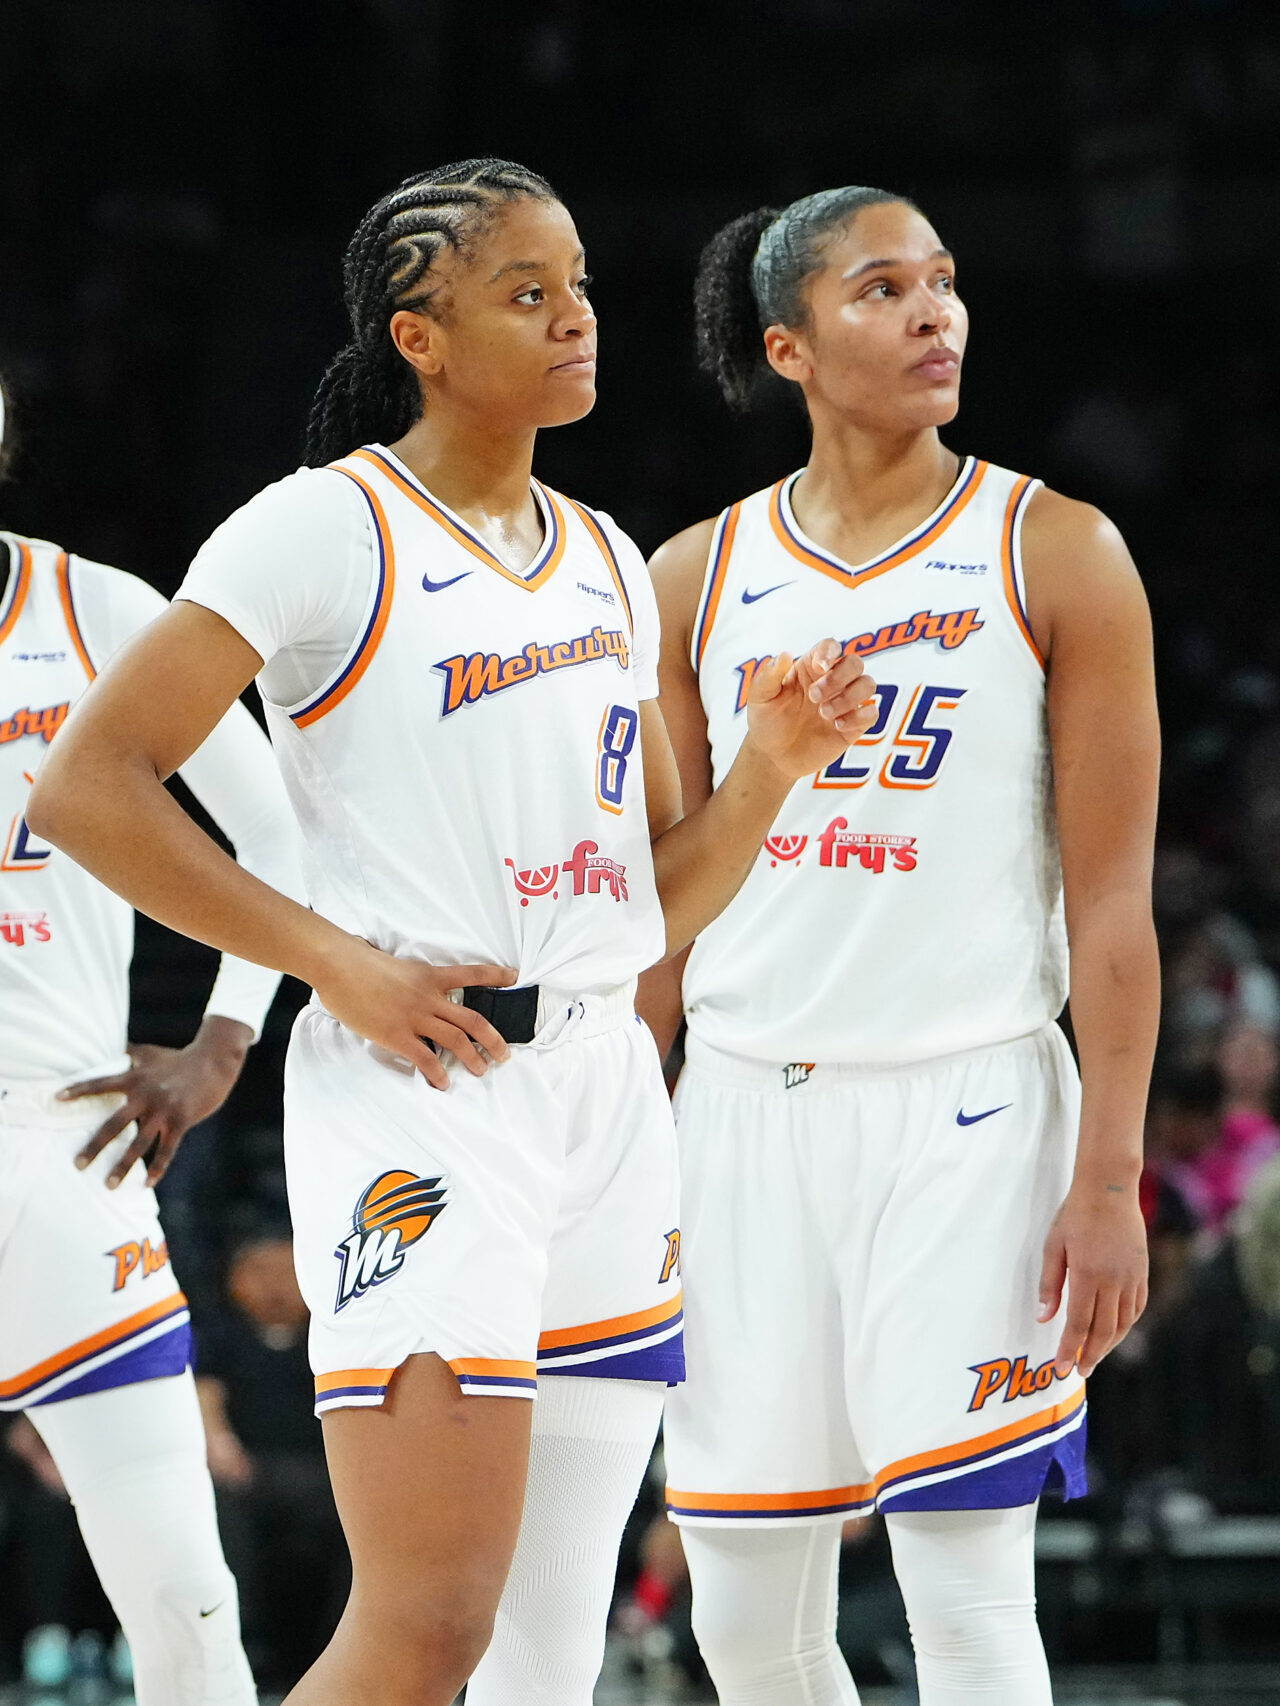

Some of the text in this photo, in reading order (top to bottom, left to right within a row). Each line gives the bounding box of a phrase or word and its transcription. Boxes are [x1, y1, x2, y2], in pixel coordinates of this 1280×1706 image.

[431, 626, 630, 718] Mercury
[596, 703, 638, 816] 8
[812, 683, 968, 790] 25
[816, 816, 918, 875] fry's
